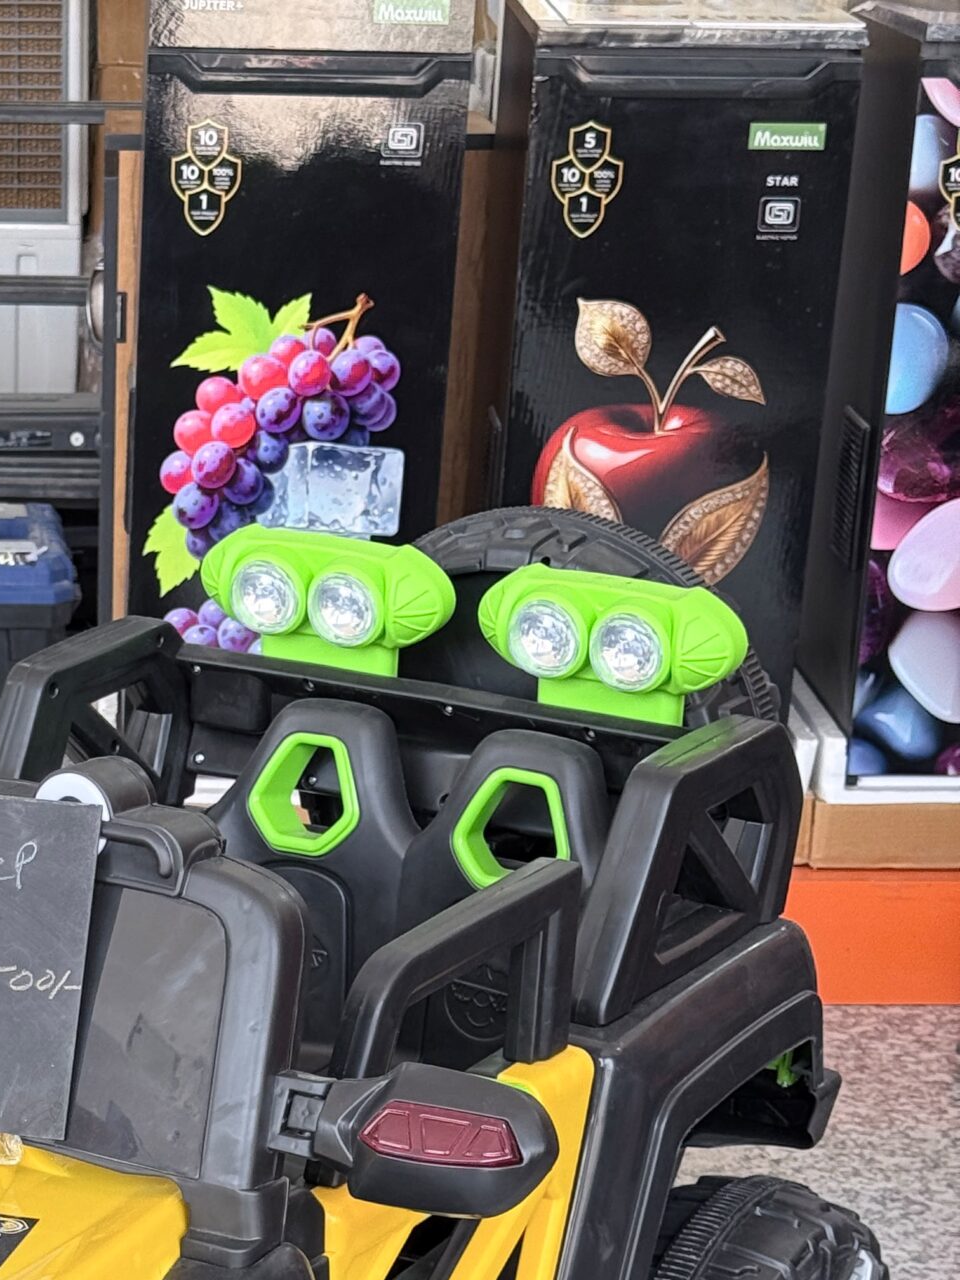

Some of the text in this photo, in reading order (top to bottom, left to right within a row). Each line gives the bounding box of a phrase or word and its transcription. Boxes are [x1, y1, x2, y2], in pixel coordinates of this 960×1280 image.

[198, 130, 218, 146] 10
[583, 132, 597, 149] 5
[180, 164, 200, 180] 10
[560, 167, 581, 183] 10
[765, 175, 800, 187] STAR
[198, 193, 208, 210] 1
[579, 195, 589, 213] 1
